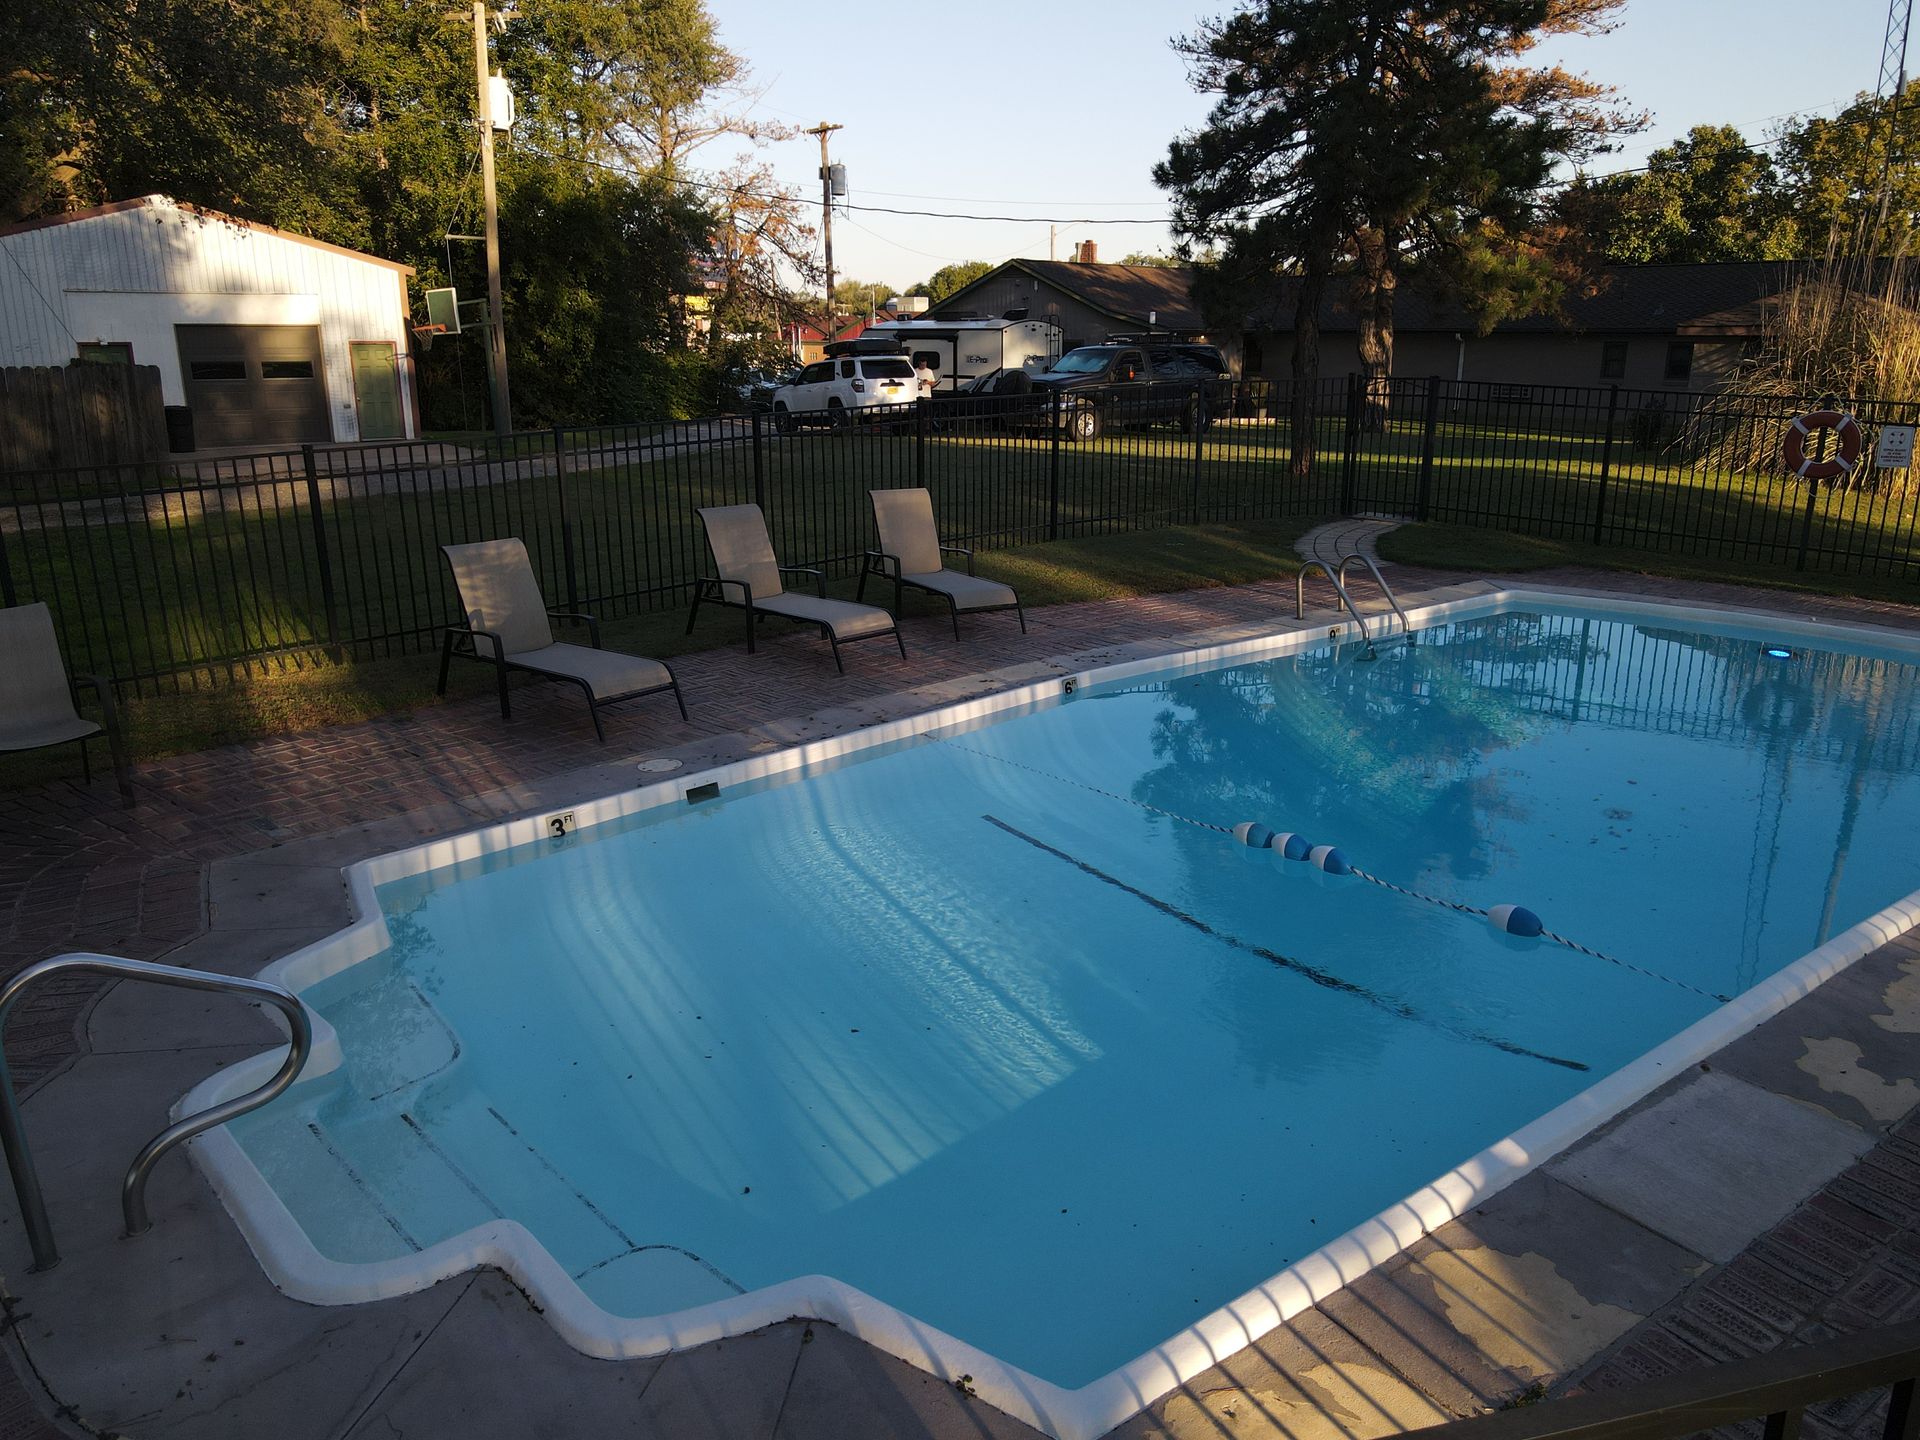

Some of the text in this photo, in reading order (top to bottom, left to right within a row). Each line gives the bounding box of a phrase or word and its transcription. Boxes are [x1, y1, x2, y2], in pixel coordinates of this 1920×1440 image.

[1065, 681, 1072, 694] 6
[551, 814, 572, 837] 3 FT
